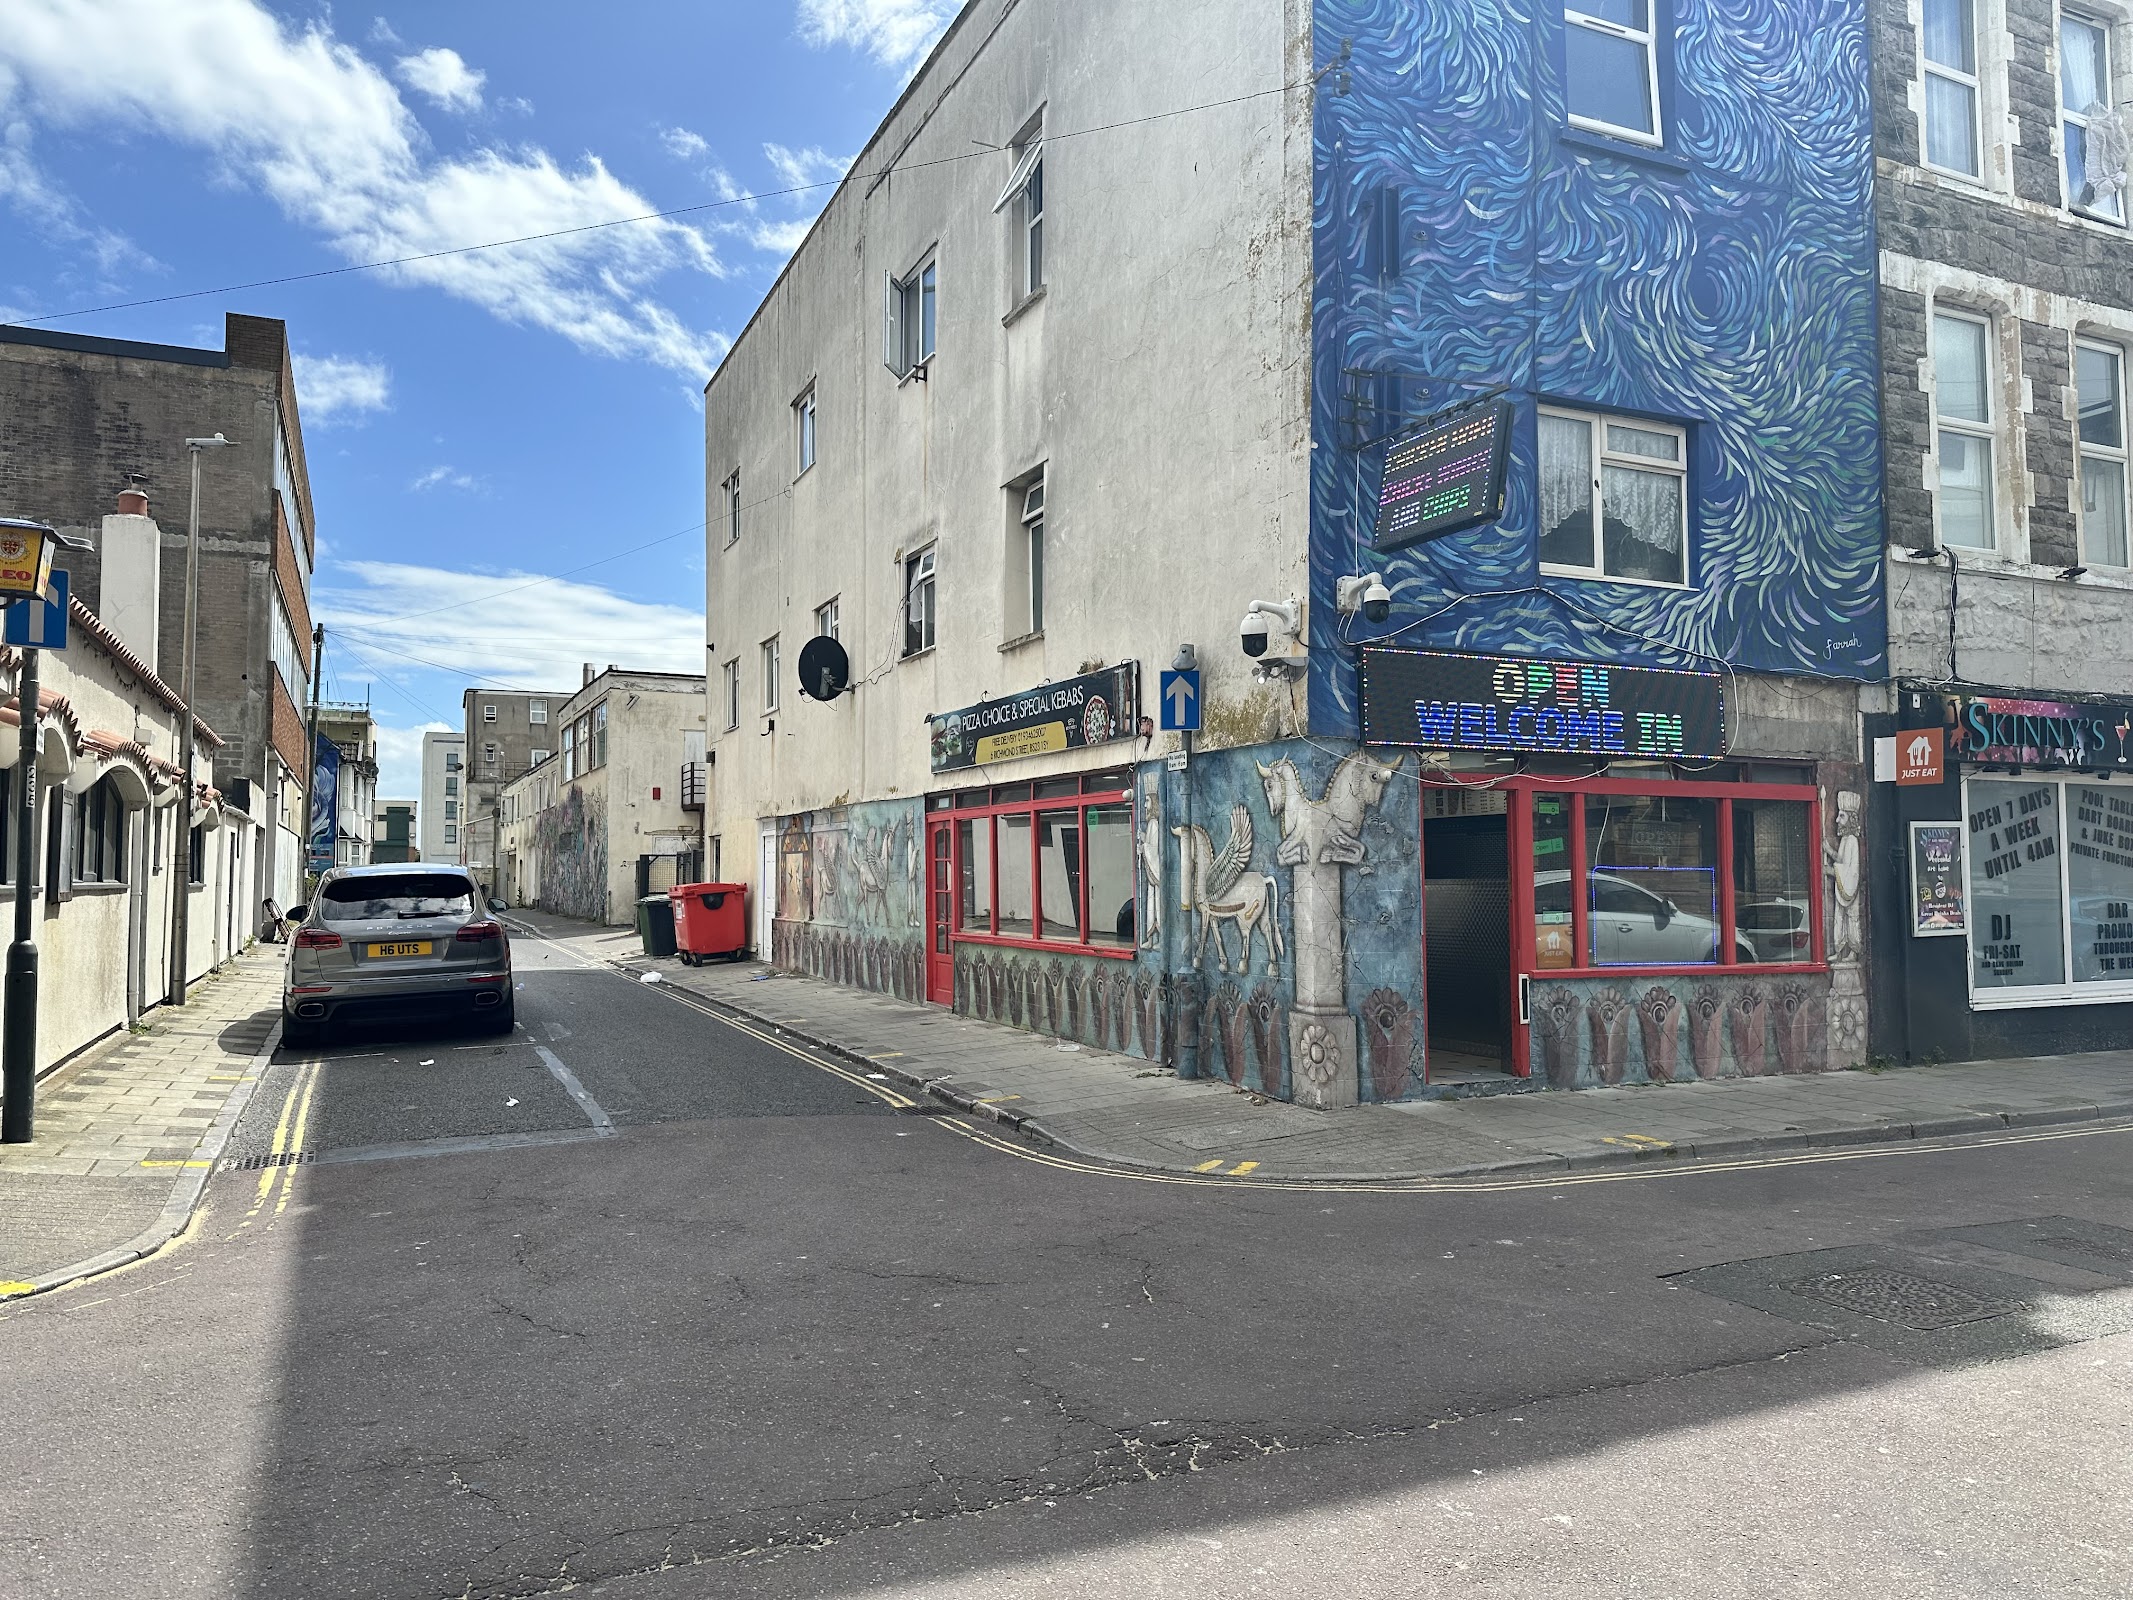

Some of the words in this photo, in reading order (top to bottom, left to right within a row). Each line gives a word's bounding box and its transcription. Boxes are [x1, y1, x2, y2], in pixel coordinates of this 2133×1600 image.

[1493, 664, 1609, 708] OPEN
[962, 713, 981, 732] PIZZA
[981, 704, 1010, 727] CHOICE
[1011, 703, 1019, 720] &
[1019, 695, 1050, 718] SPECIAL
[1051, 685, 1084, 711] KEBABS
[1415, 700, 1625, 750] WELCOME
[1636, 712, 1683, 752] IN
[1969, 703, 2105, 751] SKINNY'S
[1902, 769, 1921, 779] JUST
[1921, 767, 1938, 777] EAT
[2082, 789, 2104, 808] POOL
[1969, 805, 2001, 833] OPEN
[2005, 801, 2014, 819] 7
[2019, 787, 2051, 815] DAYS
[2078, 806, 2102, 825] DART
[1990, 832, 2000, 852] A
[2004, 816, 2041, 845] WEEK
[2081, 827, 2088, 839] &
[2092, 828, 2114, 846] JUKE
[1984, 850, 2022, 879] UNTIL
[2027, 836, 2055, 862] 4AM
[2070, 842, 2099, 859] PRIVATE
[2107, 903, 2128, 918] BAR
[1991, 914, 2012, 940] DJ
[2097, 923, 2133, 939] PROMO
[380, 945, 394, 955] H6
[397, 944, 419, 954] UTS
[1983, 945, 2021, 959] FRI-SAT
[2100, 958, 2115, 970] THE
